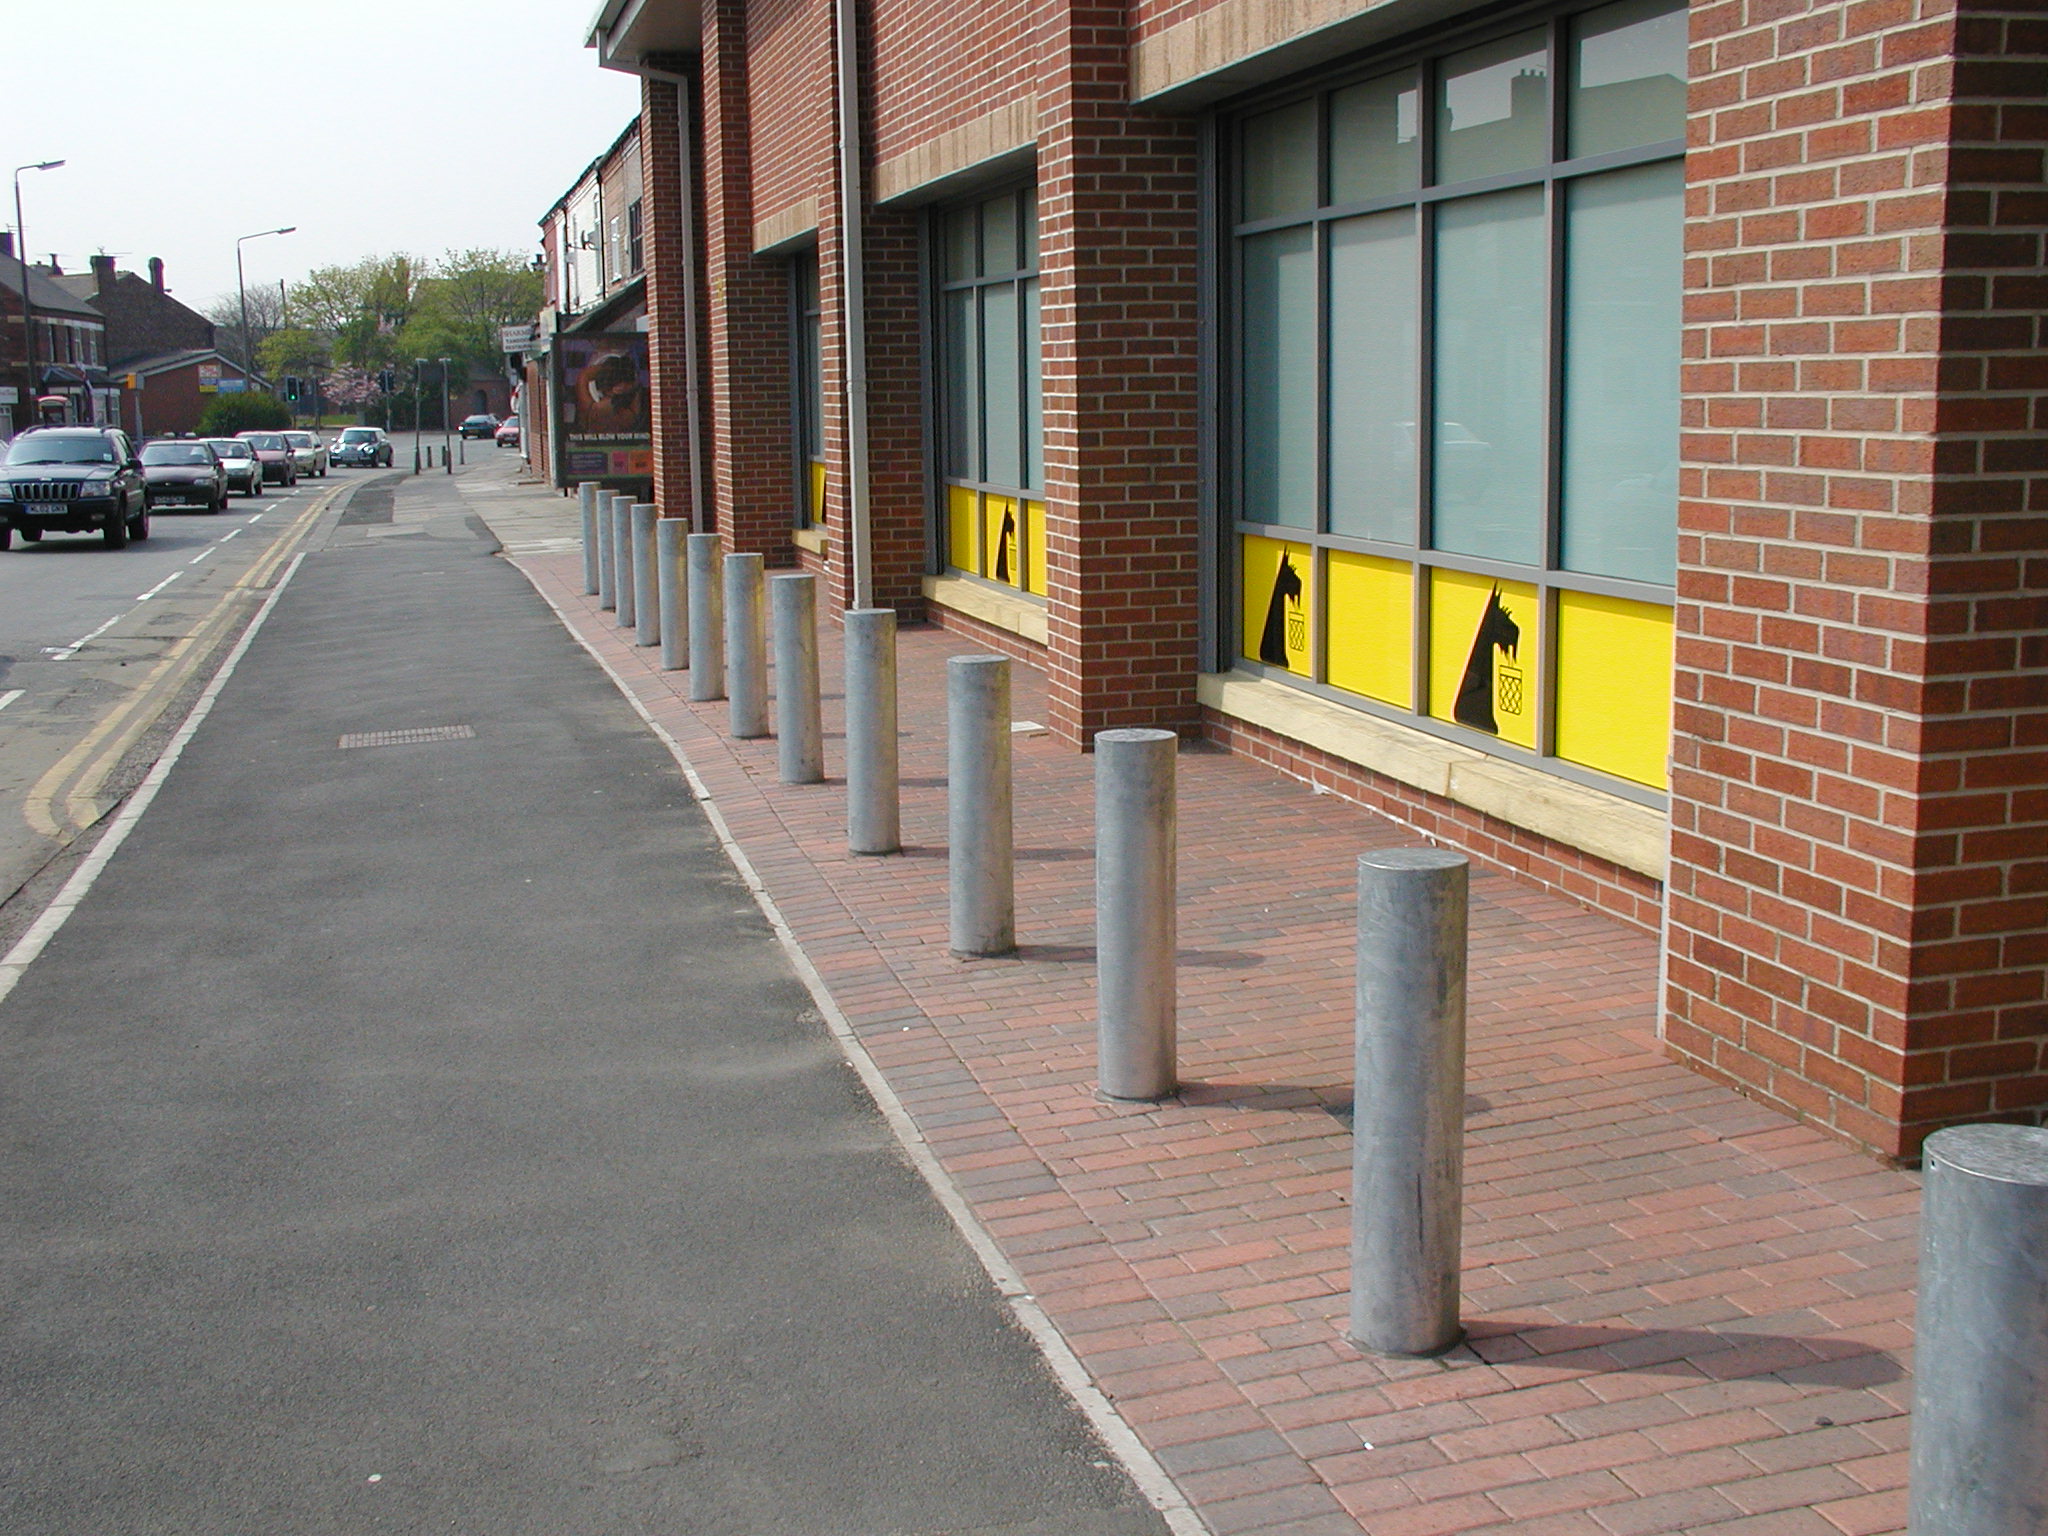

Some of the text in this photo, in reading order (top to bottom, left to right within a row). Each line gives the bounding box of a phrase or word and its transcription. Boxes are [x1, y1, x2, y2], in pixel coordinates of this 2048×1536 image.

[569, 433, 583, 441] THIS
[584, 433, 597, 441] WILL
[617, 432, 633, 440] YOUR
[634, 432, 651, 440] MIND
